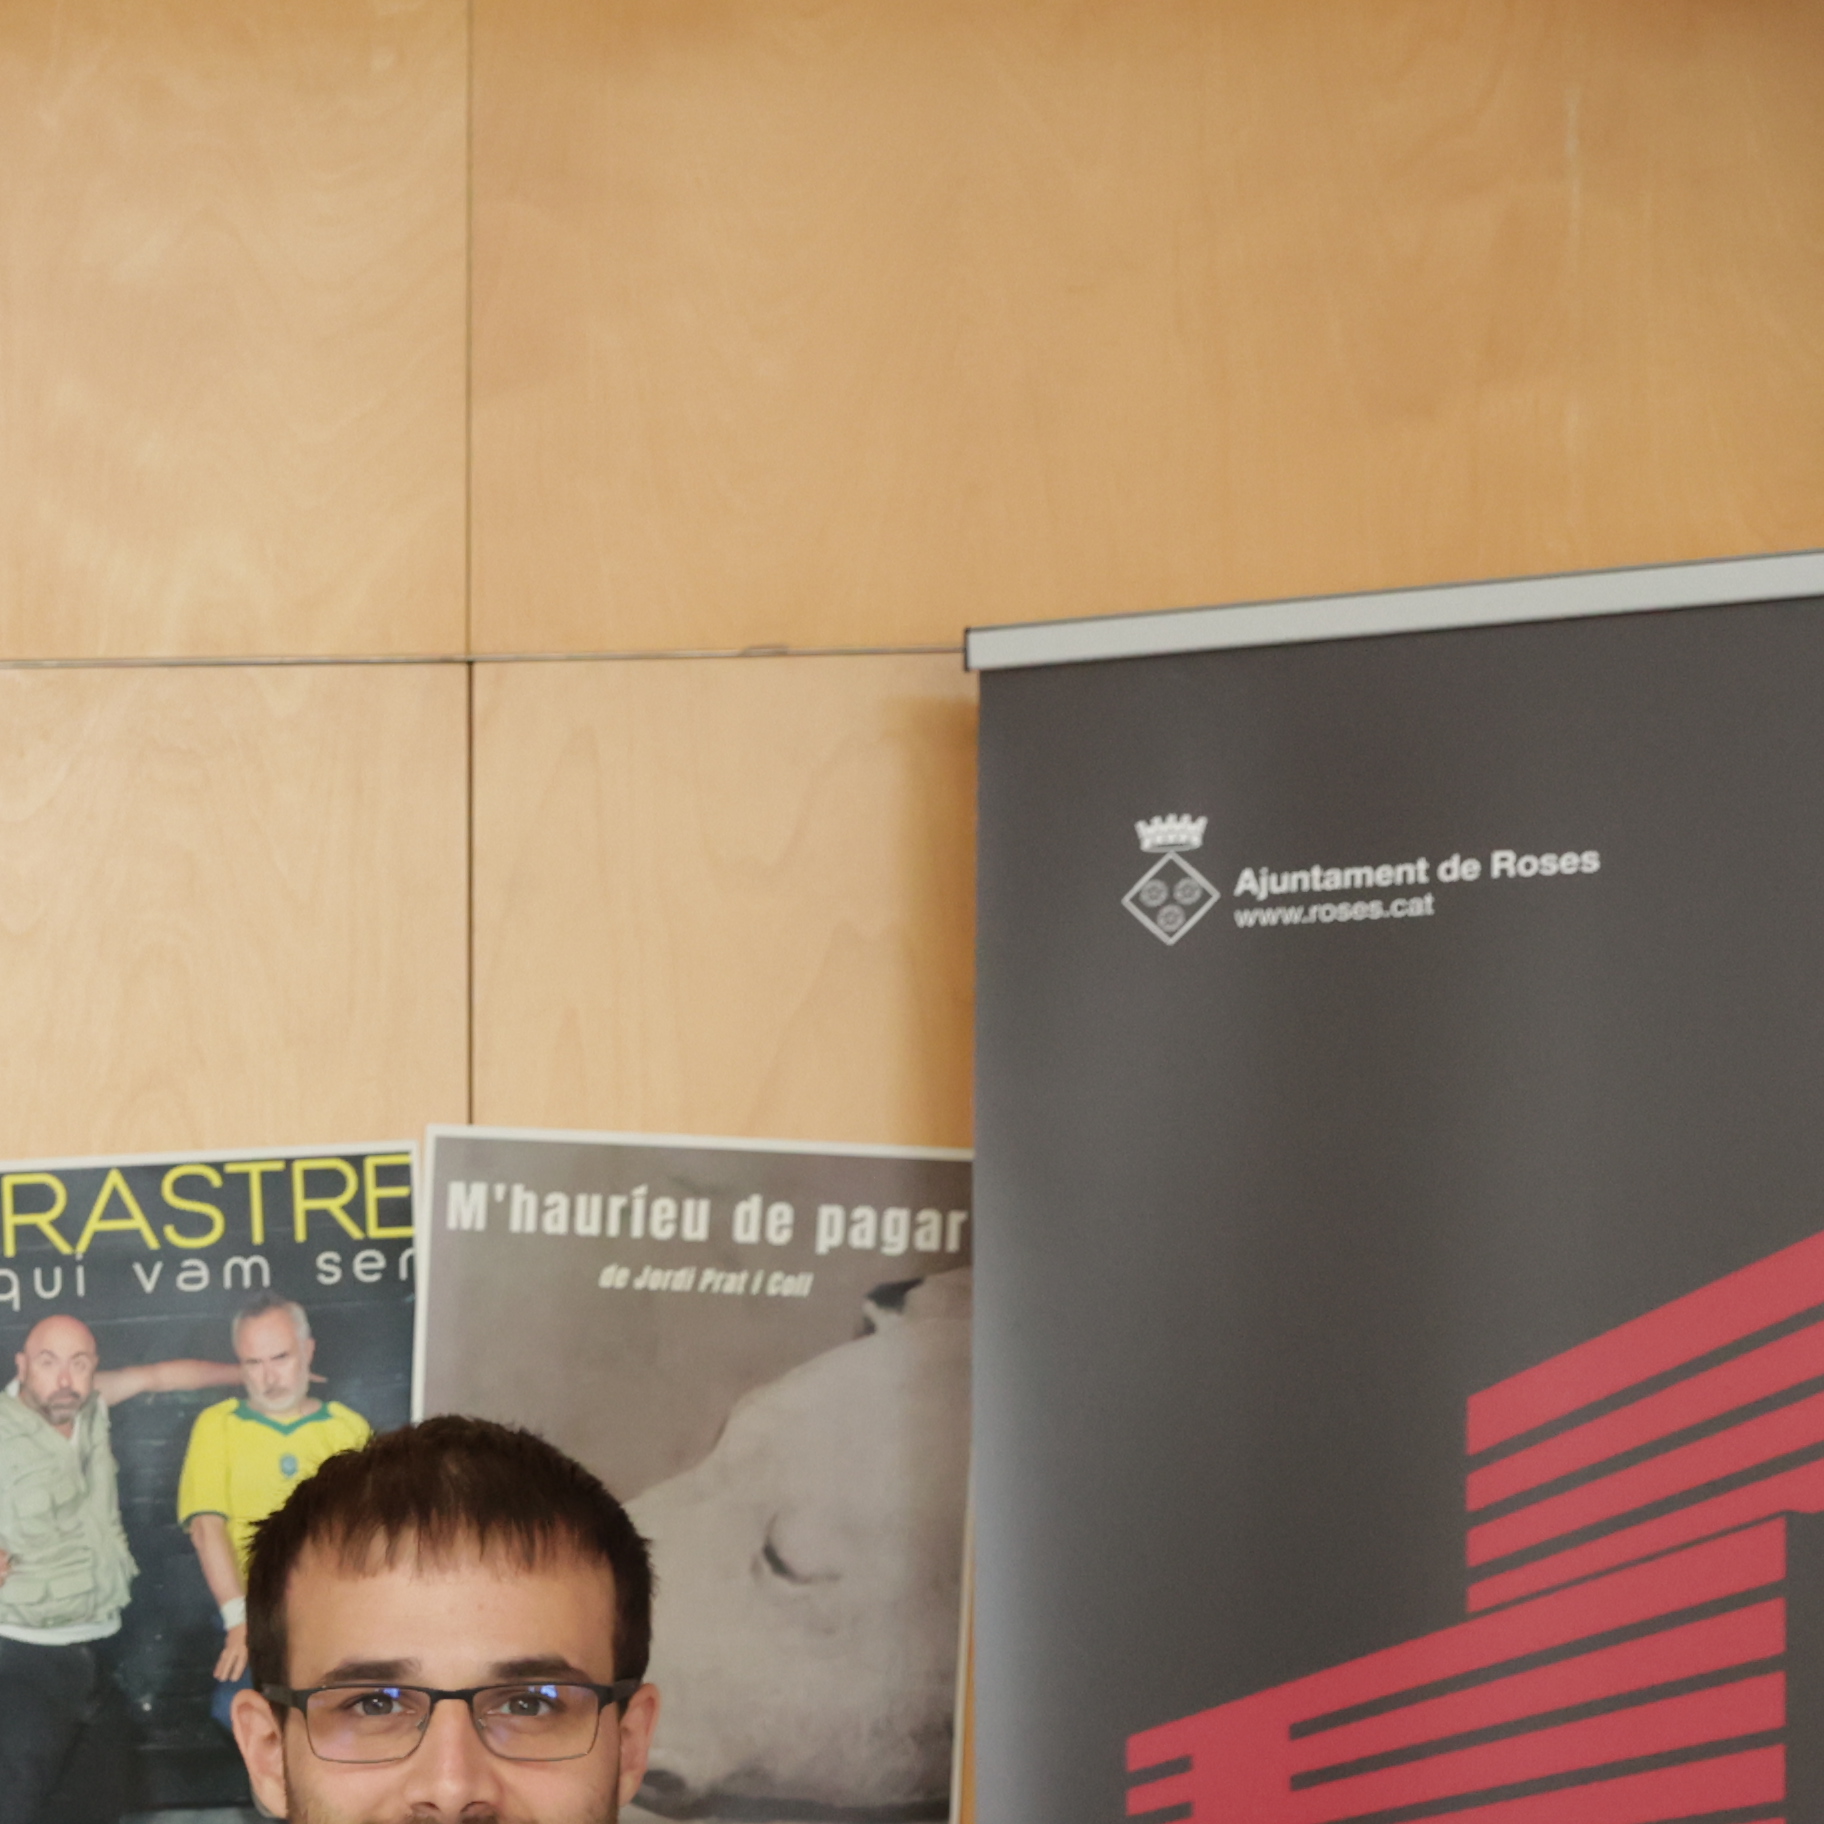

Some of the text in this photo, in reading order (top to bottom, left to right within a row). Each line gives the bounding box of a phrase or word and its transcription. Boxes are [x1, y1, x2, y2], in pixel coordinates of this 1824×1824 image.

[1234, 849, 1601, 901] Ajuntament de Roses
[1234, 892, 1435, 928] www.roses.cat
[1, 1152, 414, 1258] RASTRE
[733, 1194, 795, 1246] de
[815, 1203, 969, 1257] pagar
[132, 1253, 272, 1295] vam
[598, 1262, 814, 1298] de Jordi Prat Coll
